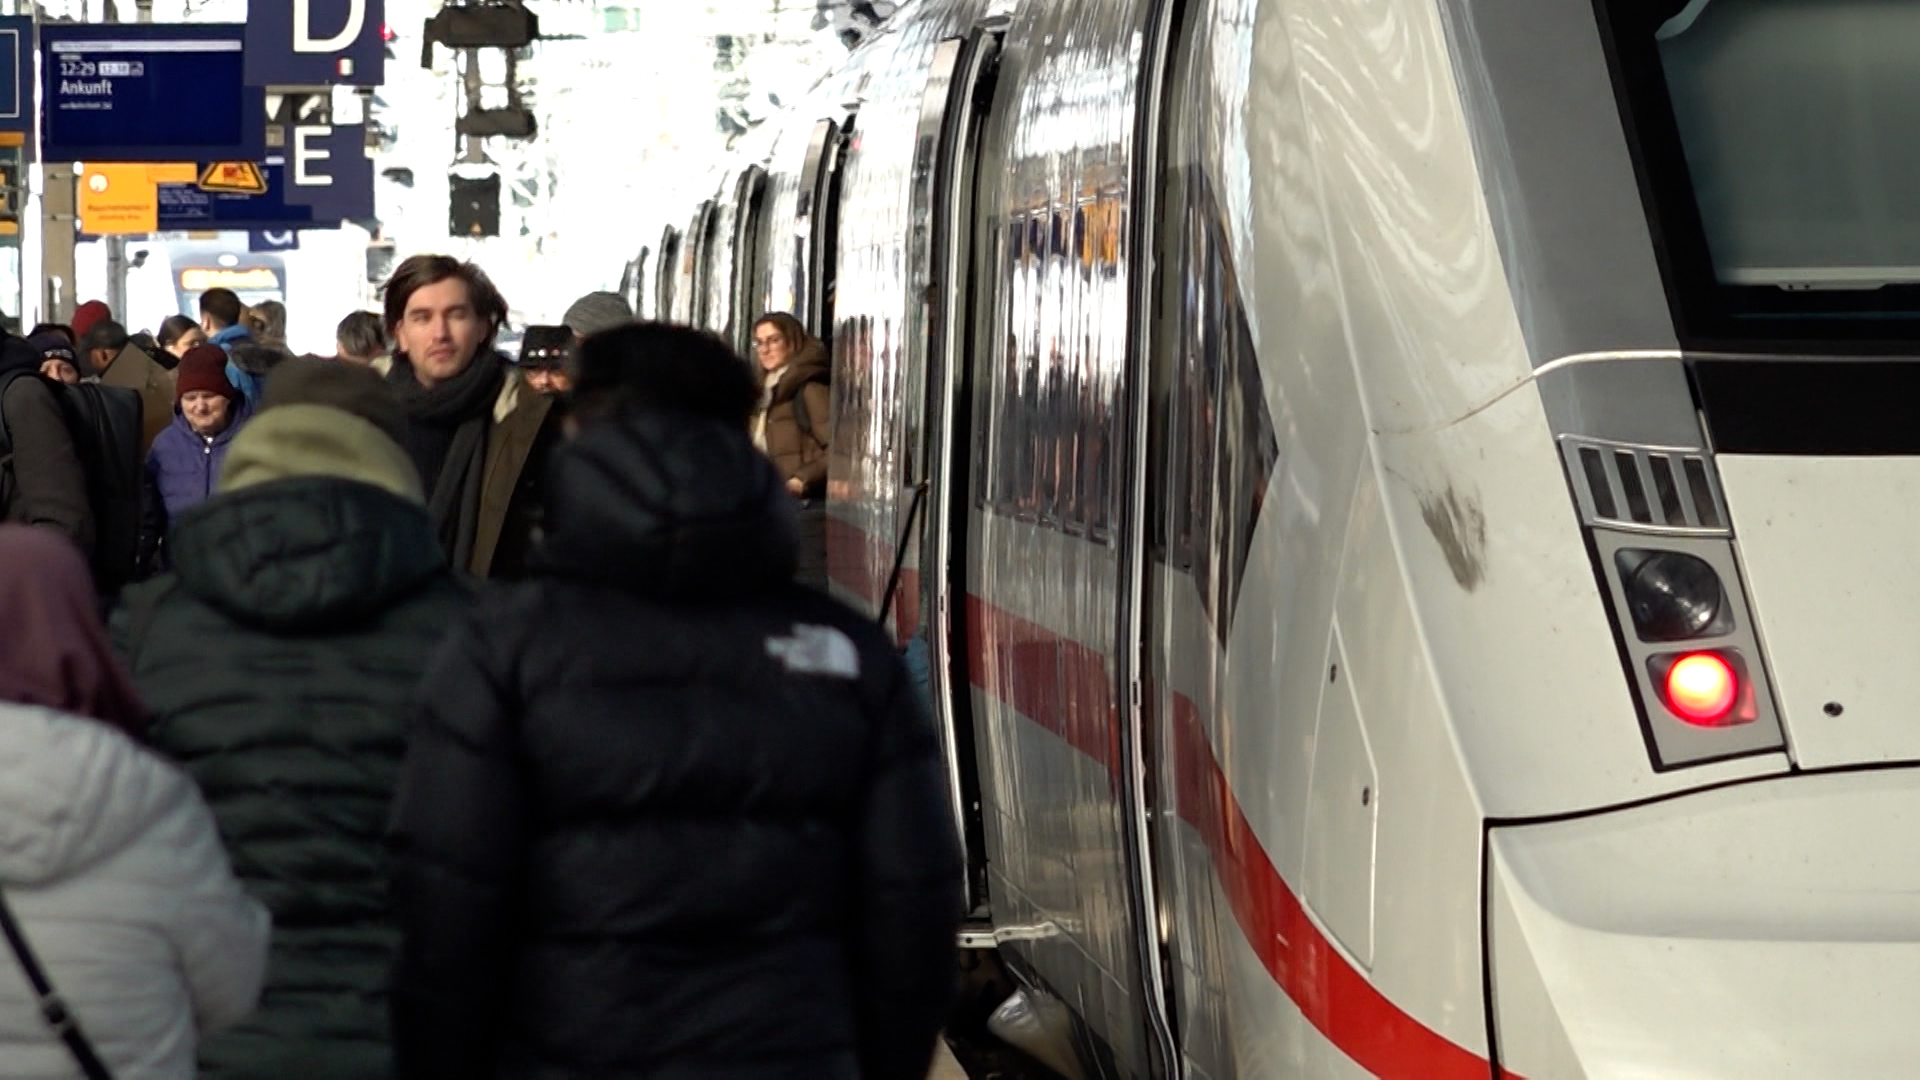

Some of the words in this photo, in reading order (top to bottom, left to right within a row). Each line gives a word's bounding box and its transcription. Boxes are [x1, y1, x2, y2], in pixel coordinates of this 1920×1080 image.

[293, 0, 366, 52] D
[60, 61, 96, 76] 12:29
[60, 79, 112, 95] Ankunft
[294, 125, 333, 185] E
